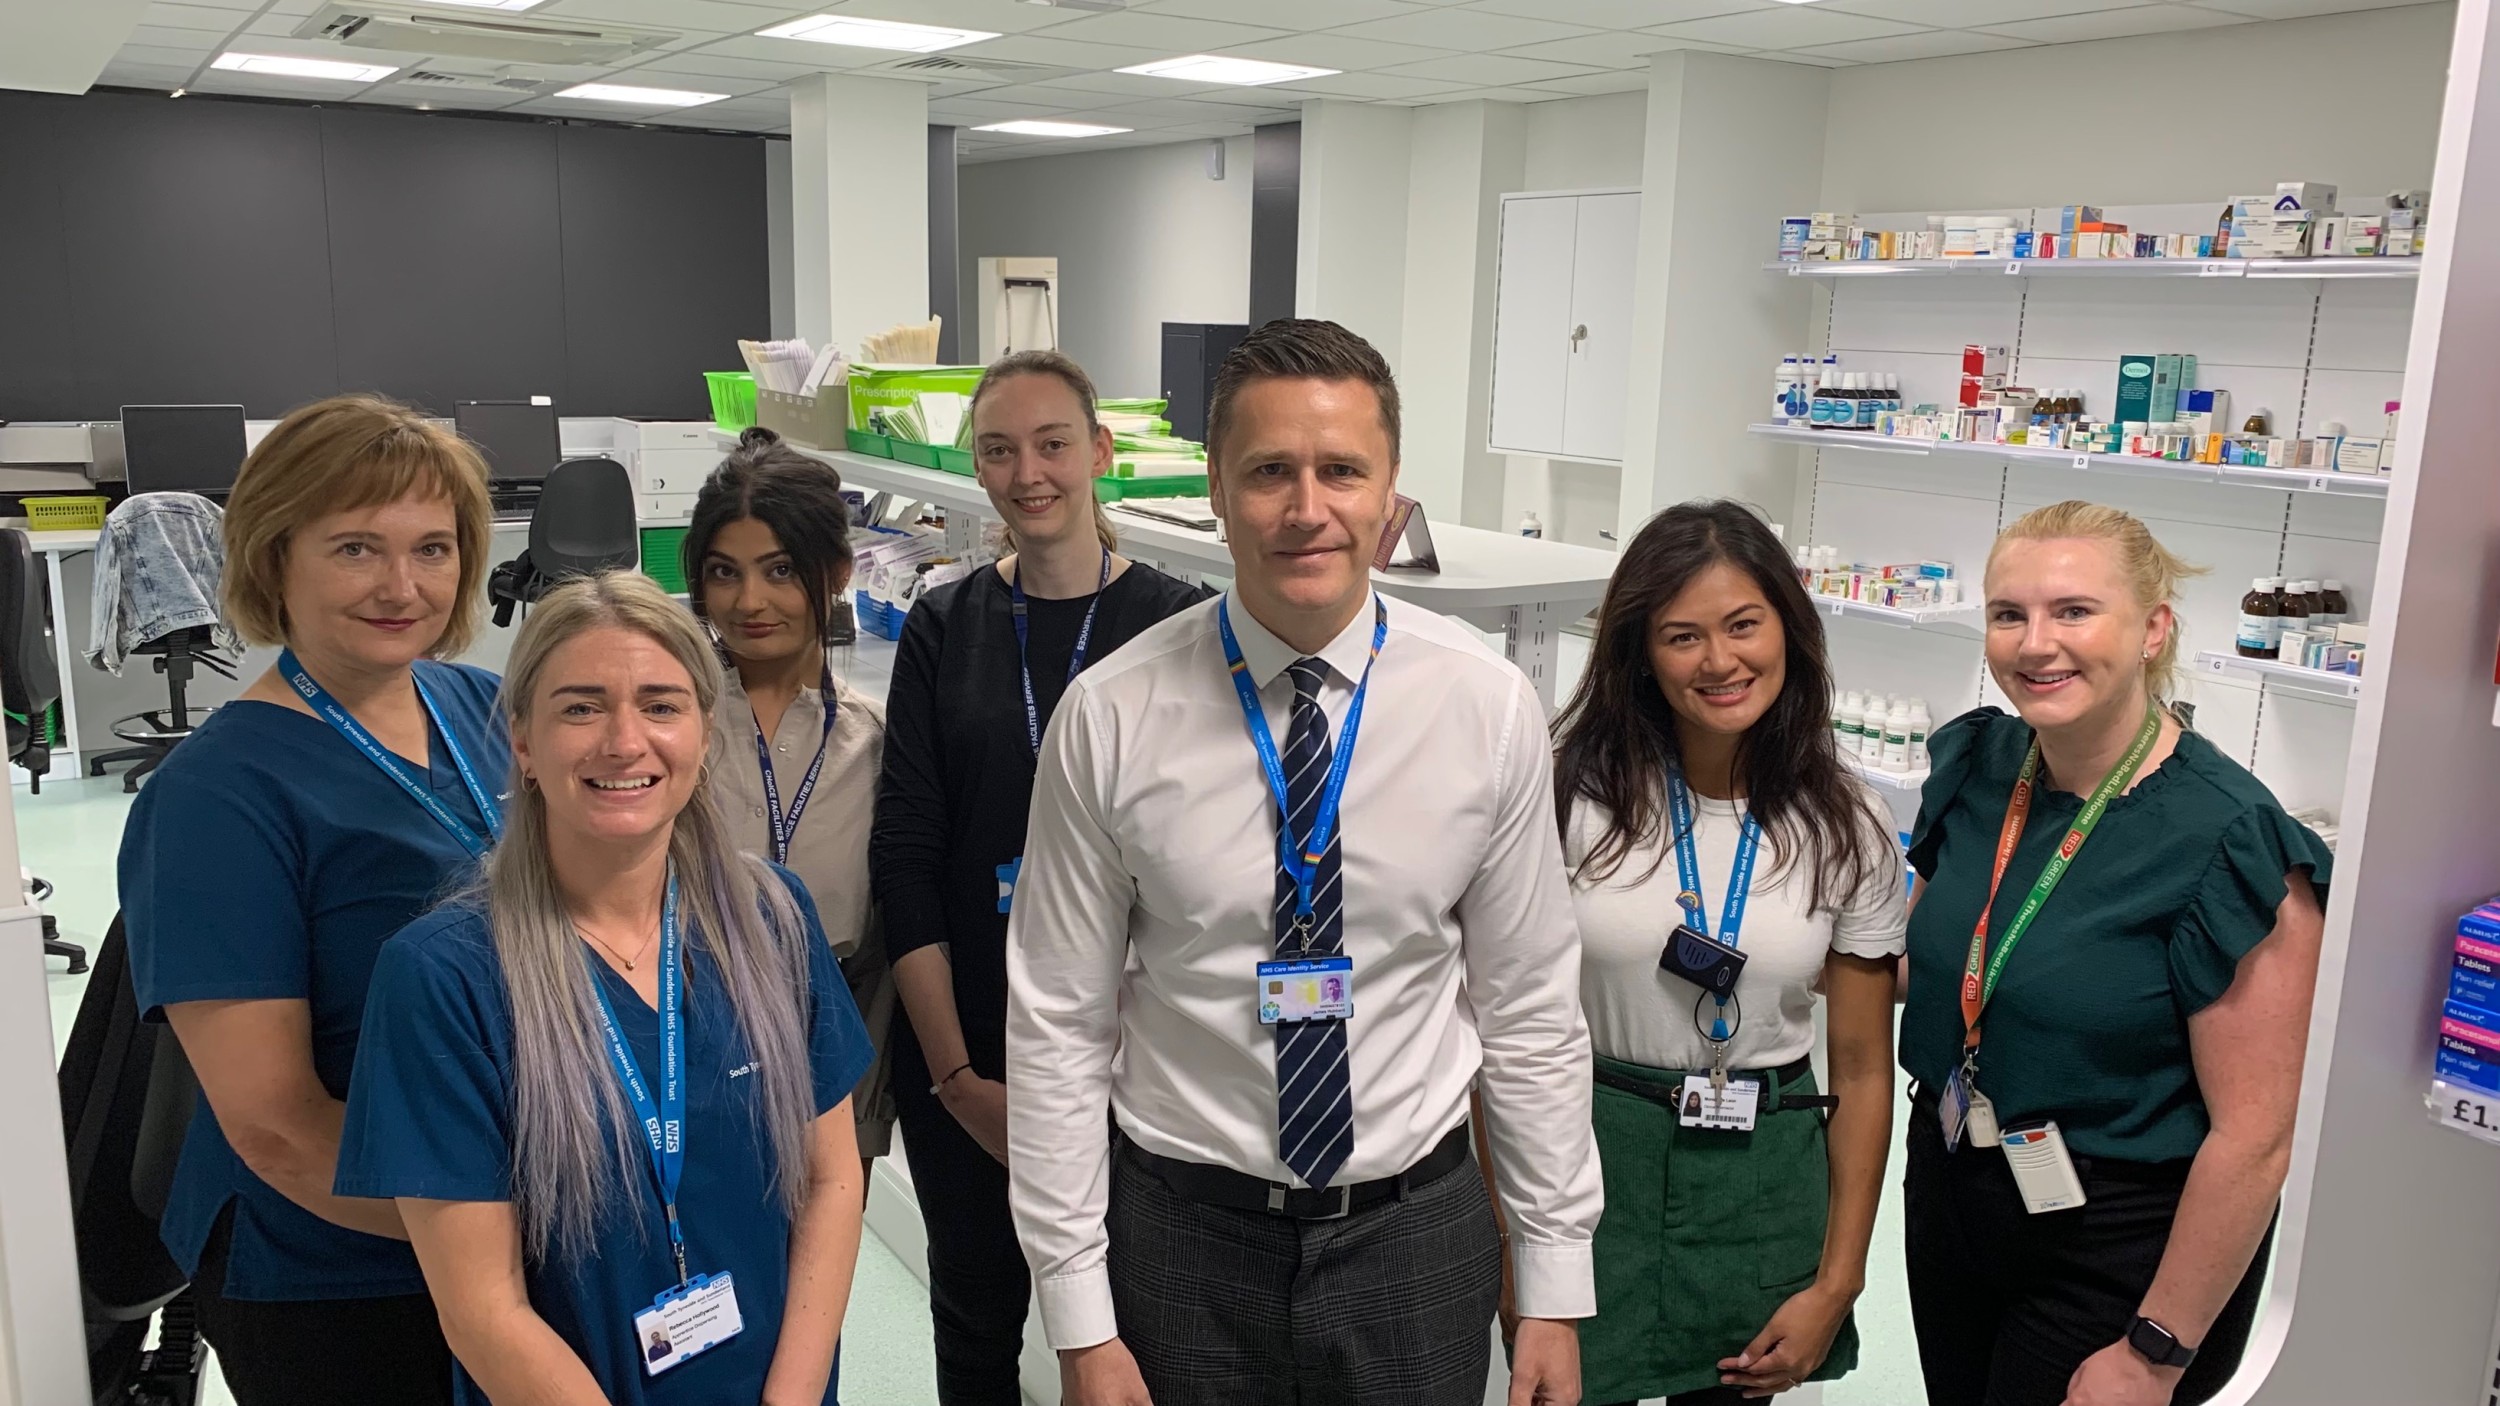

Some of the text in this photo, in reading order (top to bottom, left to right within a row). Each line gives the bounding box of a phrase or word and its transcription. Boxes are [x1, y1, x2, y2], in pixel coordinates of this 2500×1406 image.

[2010, 264, 2016, 272] B
[2207, 264, 2213, 272] C
[2078, 457, 2084, 465] D
[2315, 478, 2322, 487] E
[2213, 661, 2221, 669] G
[1028, 705, 1038, 746] FACILITIES
[294, 674, 317, 696] NHS
[325, 705, 344, 723] South
[343, 721, 369, 746] Tyneside
[367, 745, 381, 757] and
[380, 755, 414, 787] Sunderland
[412, 784, 427, 798] NHS
[426, 797, 457, 828] Foundation
[791, 780, 813, 819] FACILITIES
[770, 799, 784, 841] FACILITIES
[1682, 838, 1693, 875] Sunderland
[1687, 876, 1695, 889] NHS
[1733, 872, 1745, 898] Tyneside
[1729, 900, 1739, 918] South
[666, 916, 675, 948] Tyneside
[2458, 956, 2491, 972] Tablets
[666, 967, 675, 1011] Sunderland
[2455, 971, 2496, 990] Pain relief
[667, 1013, 675, 1030] NHS
[607, 1027, 618, 1043] and
[667, 1032, 676, 1078] Foundation
[2443, 1037, 2476, 1055] Tablets
[614, 1044, 634, 1078] Tyneside
[2441, 1052, 2480, 1072] Pain relief
[729, 1065, 749, 1078] South
[631, 1078, 645, 1102] South
[668, 1081, 676, 1101] Trust
[667, 1122, 678, 1151] NHS
[669, 1303, 719, 1331] Rebecca Hollywood
